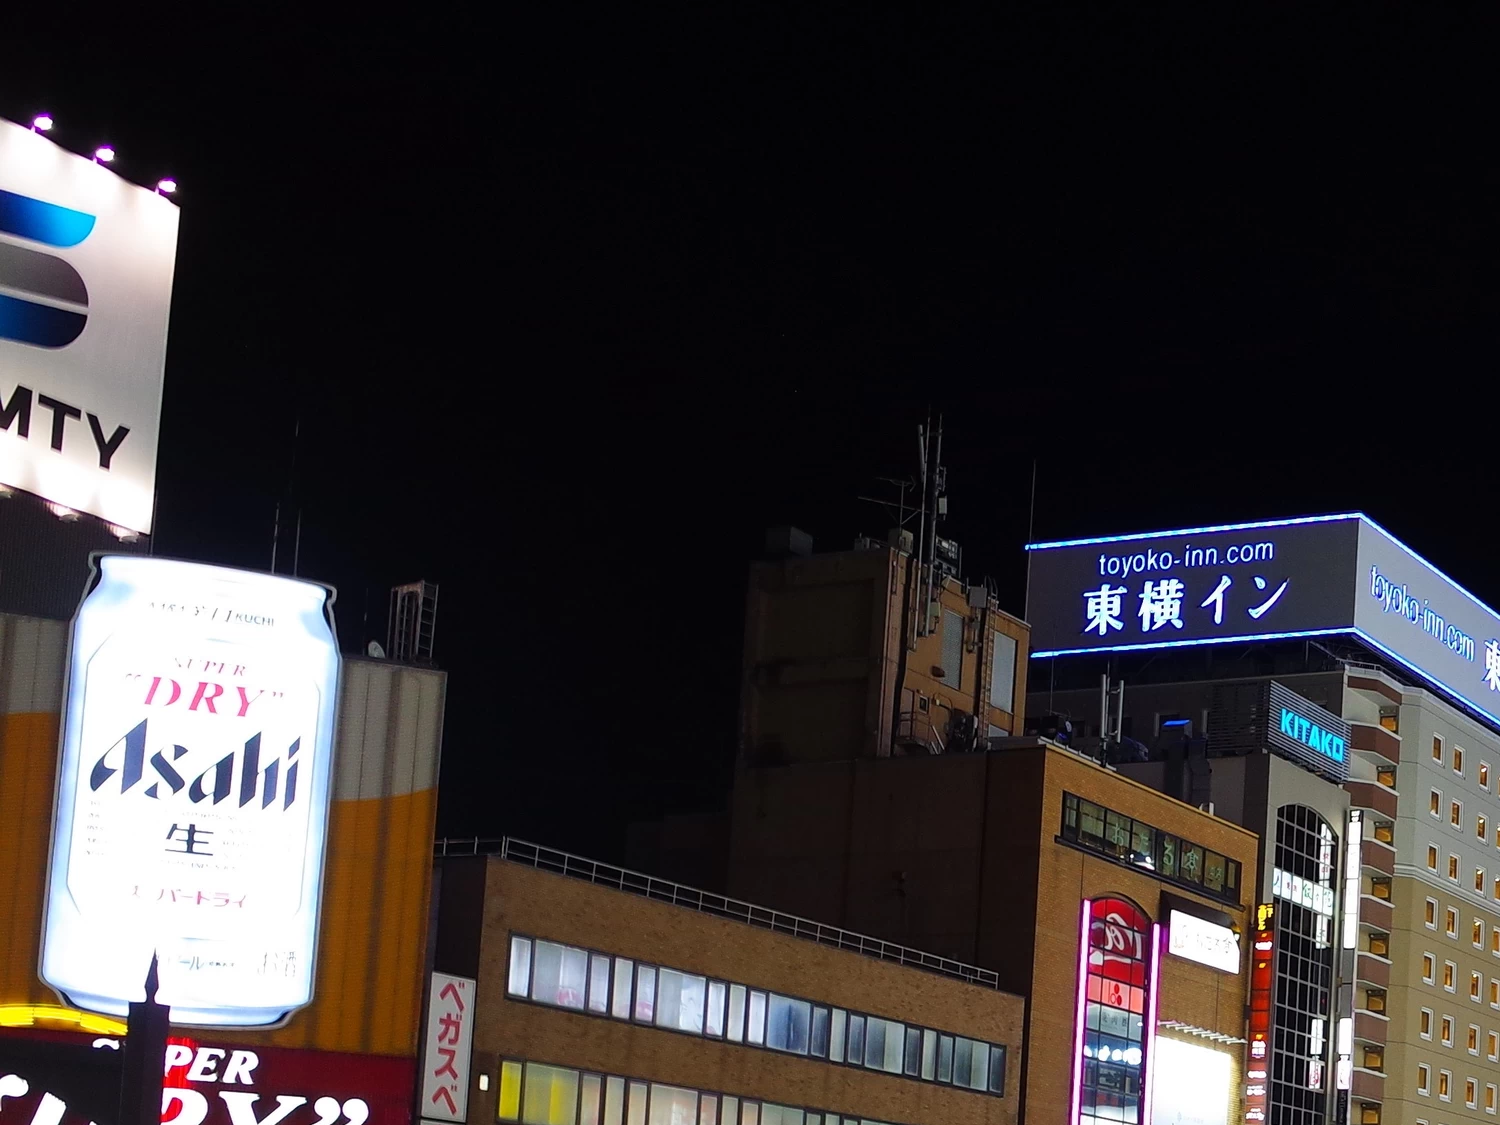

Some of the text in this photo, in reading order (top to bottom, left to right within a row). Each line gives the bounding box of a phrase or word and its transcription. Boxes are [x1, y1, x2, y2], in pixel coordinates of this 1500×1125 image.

[1100, 540, 1274, 577] toyoko-inn.com
[1083, 575, 1290, 636] 東横イン
[1370, 565, 1476, 662] toyoko-inn.com
[90, 717, 301, 811] Asahi
[1279, 708, 1345, 763] KITAKO
[165, 823, 214, 857] 生
